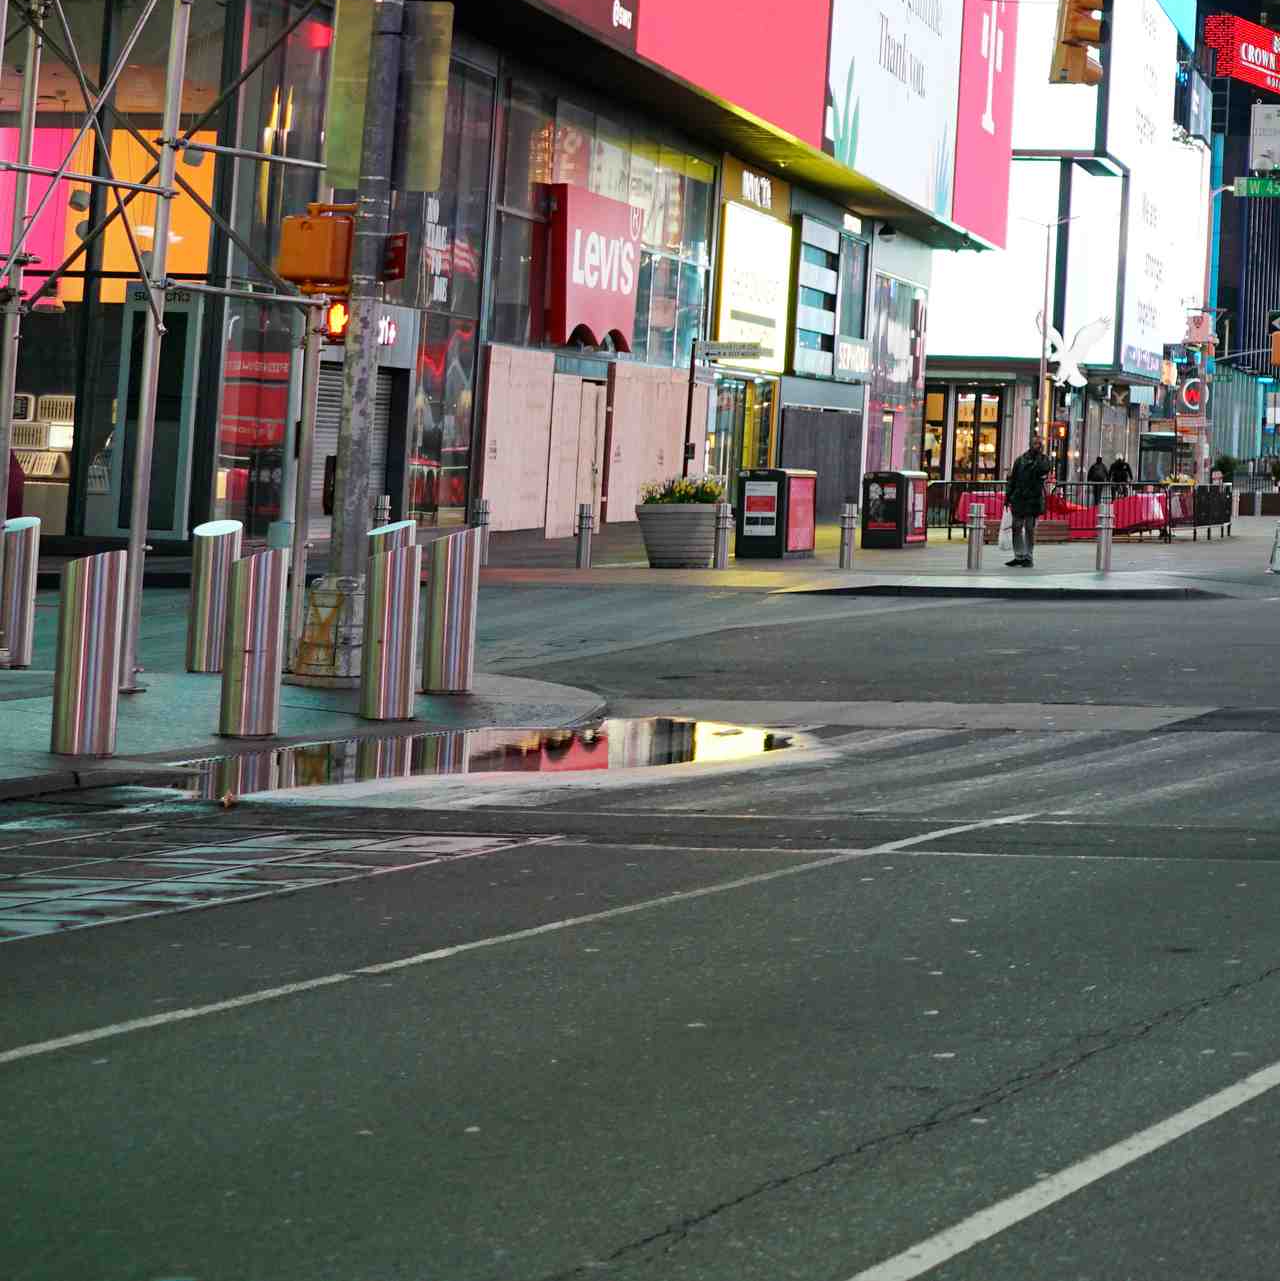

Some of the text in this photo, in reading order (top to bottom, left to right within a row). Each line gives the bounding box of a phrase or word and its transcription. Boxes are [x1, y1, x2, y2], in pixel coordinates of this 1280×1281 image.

[878, 11, 907, 85] Thank
[1266, 181, 1280, 194] 45
[571, 228, 635, 295] Levi's
